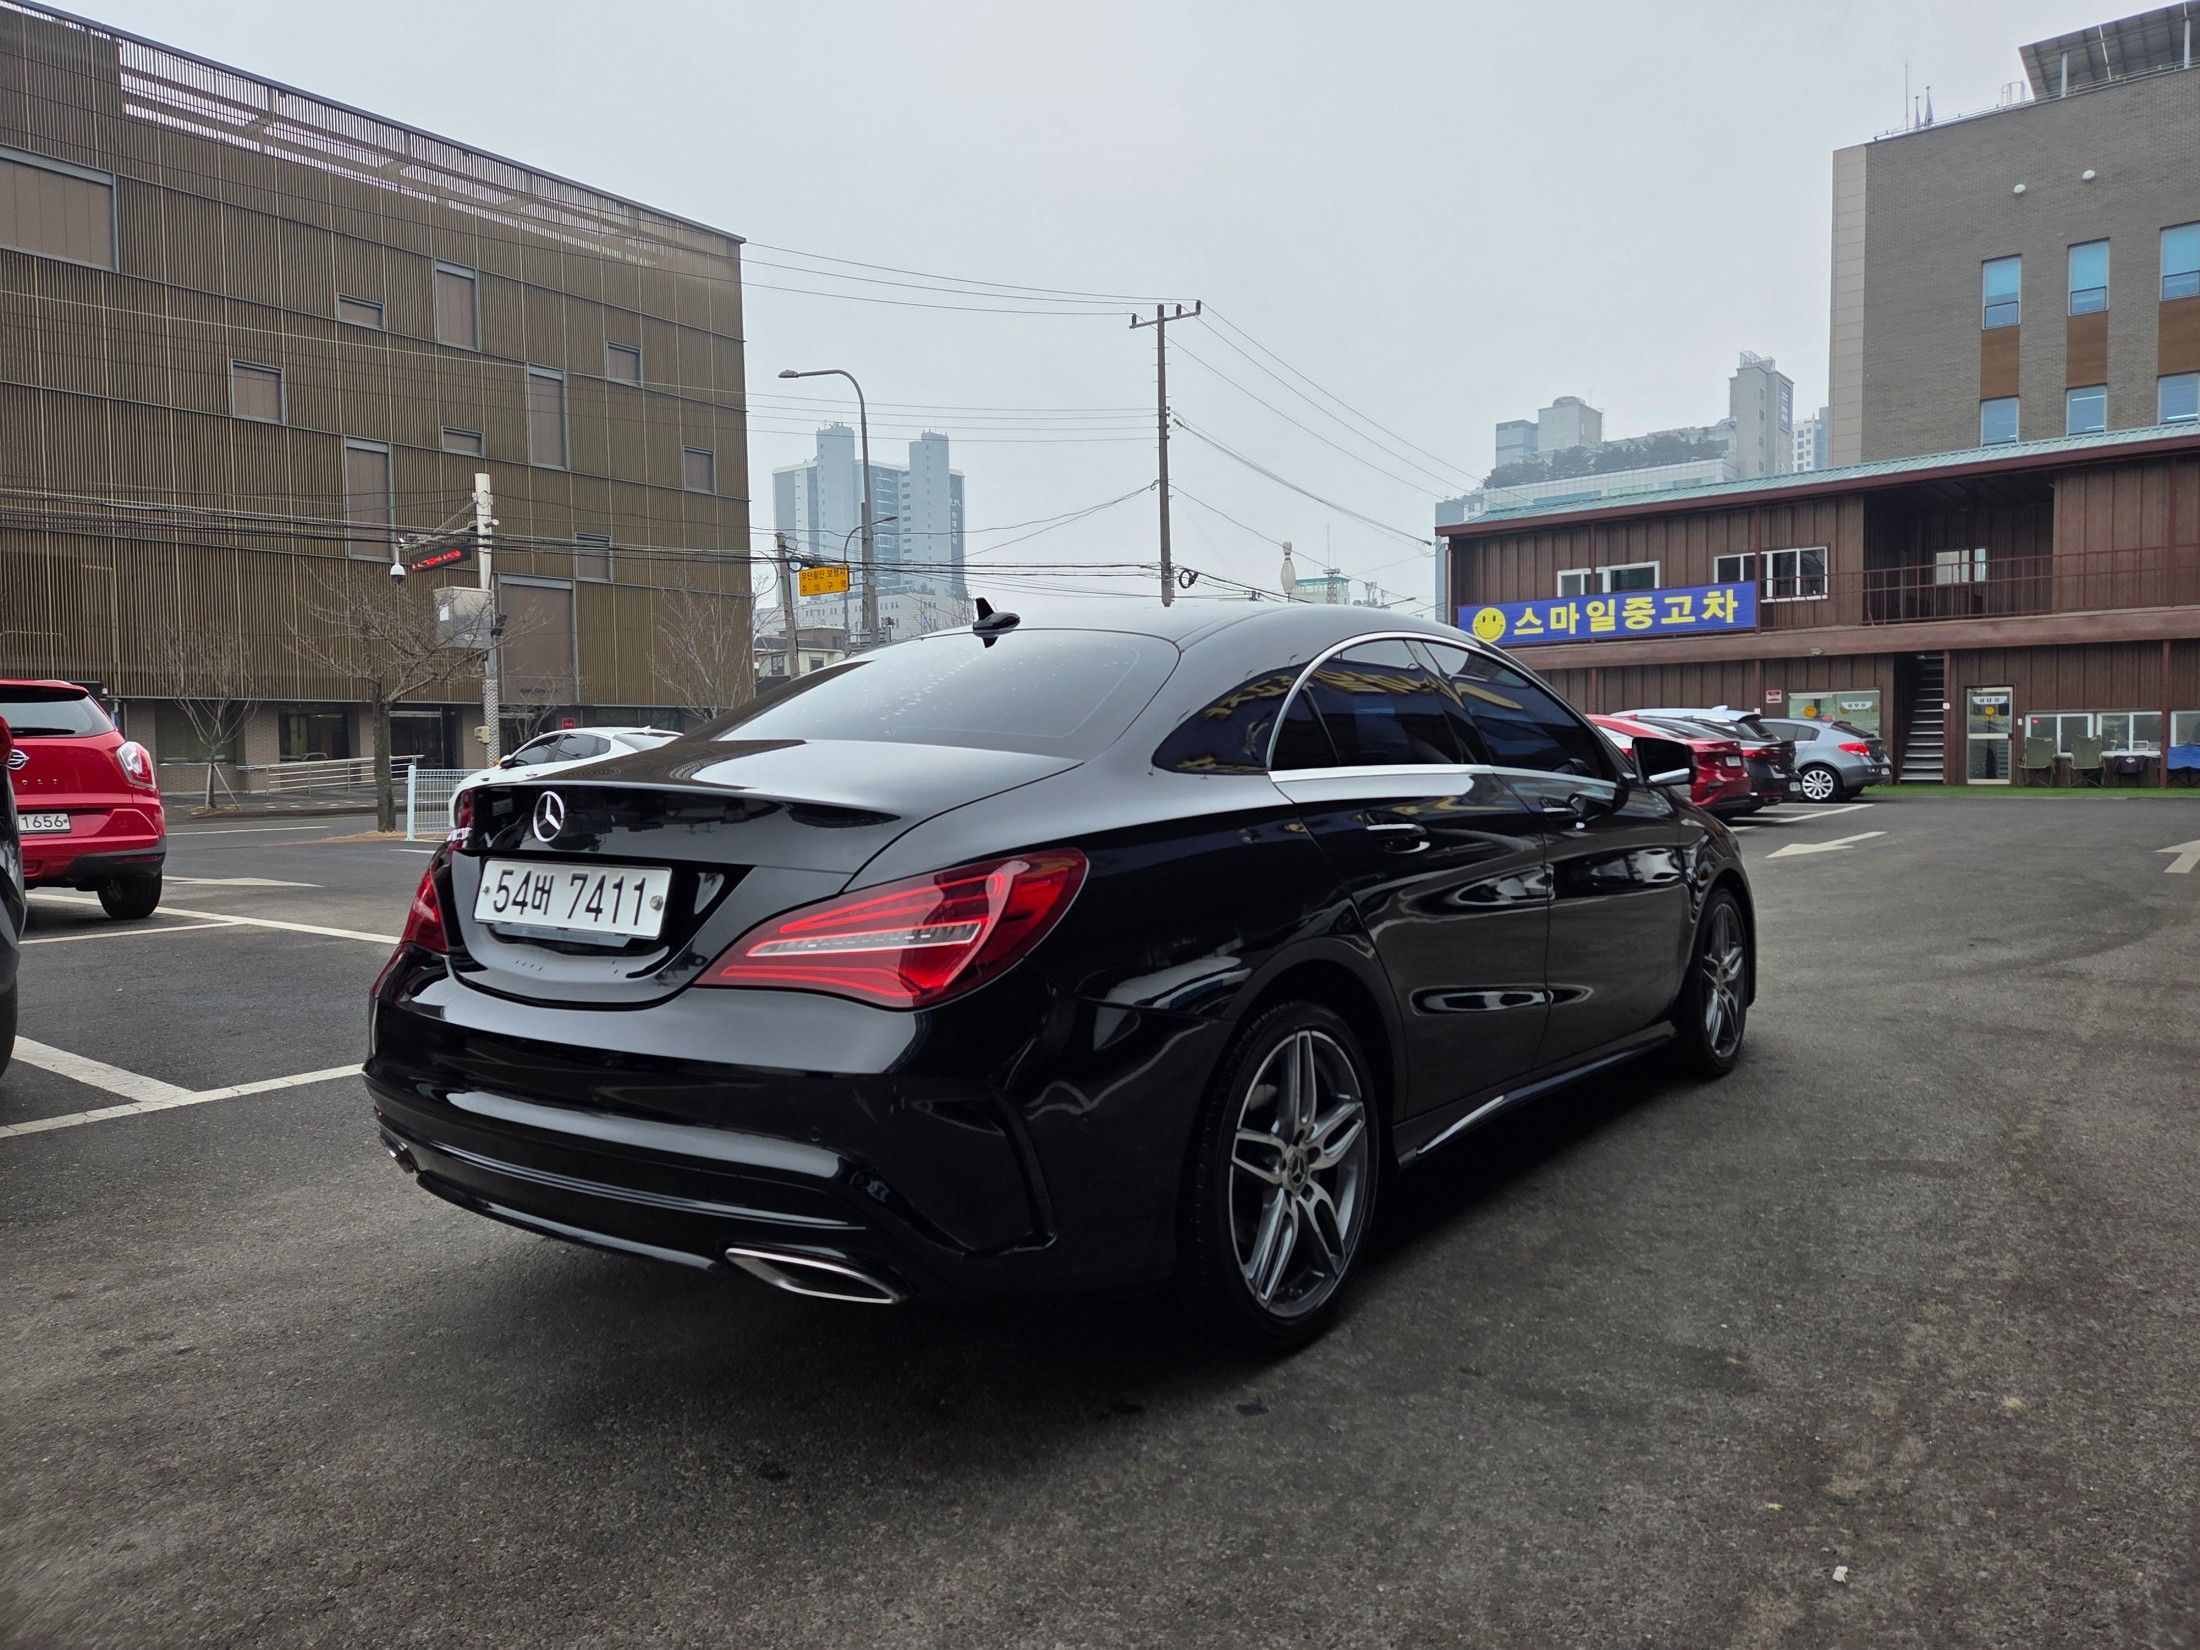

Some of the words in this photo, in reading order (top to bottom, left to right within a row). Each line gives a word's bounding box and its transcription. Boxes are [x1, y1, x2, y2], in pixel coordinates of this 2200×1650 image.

[1513, 589, 1739, 635] 스마일중고차
[22, 815, 64, 829] 1656
[493, 869, 554, 916] 54버
[567, 873, 647, 926] 7411
